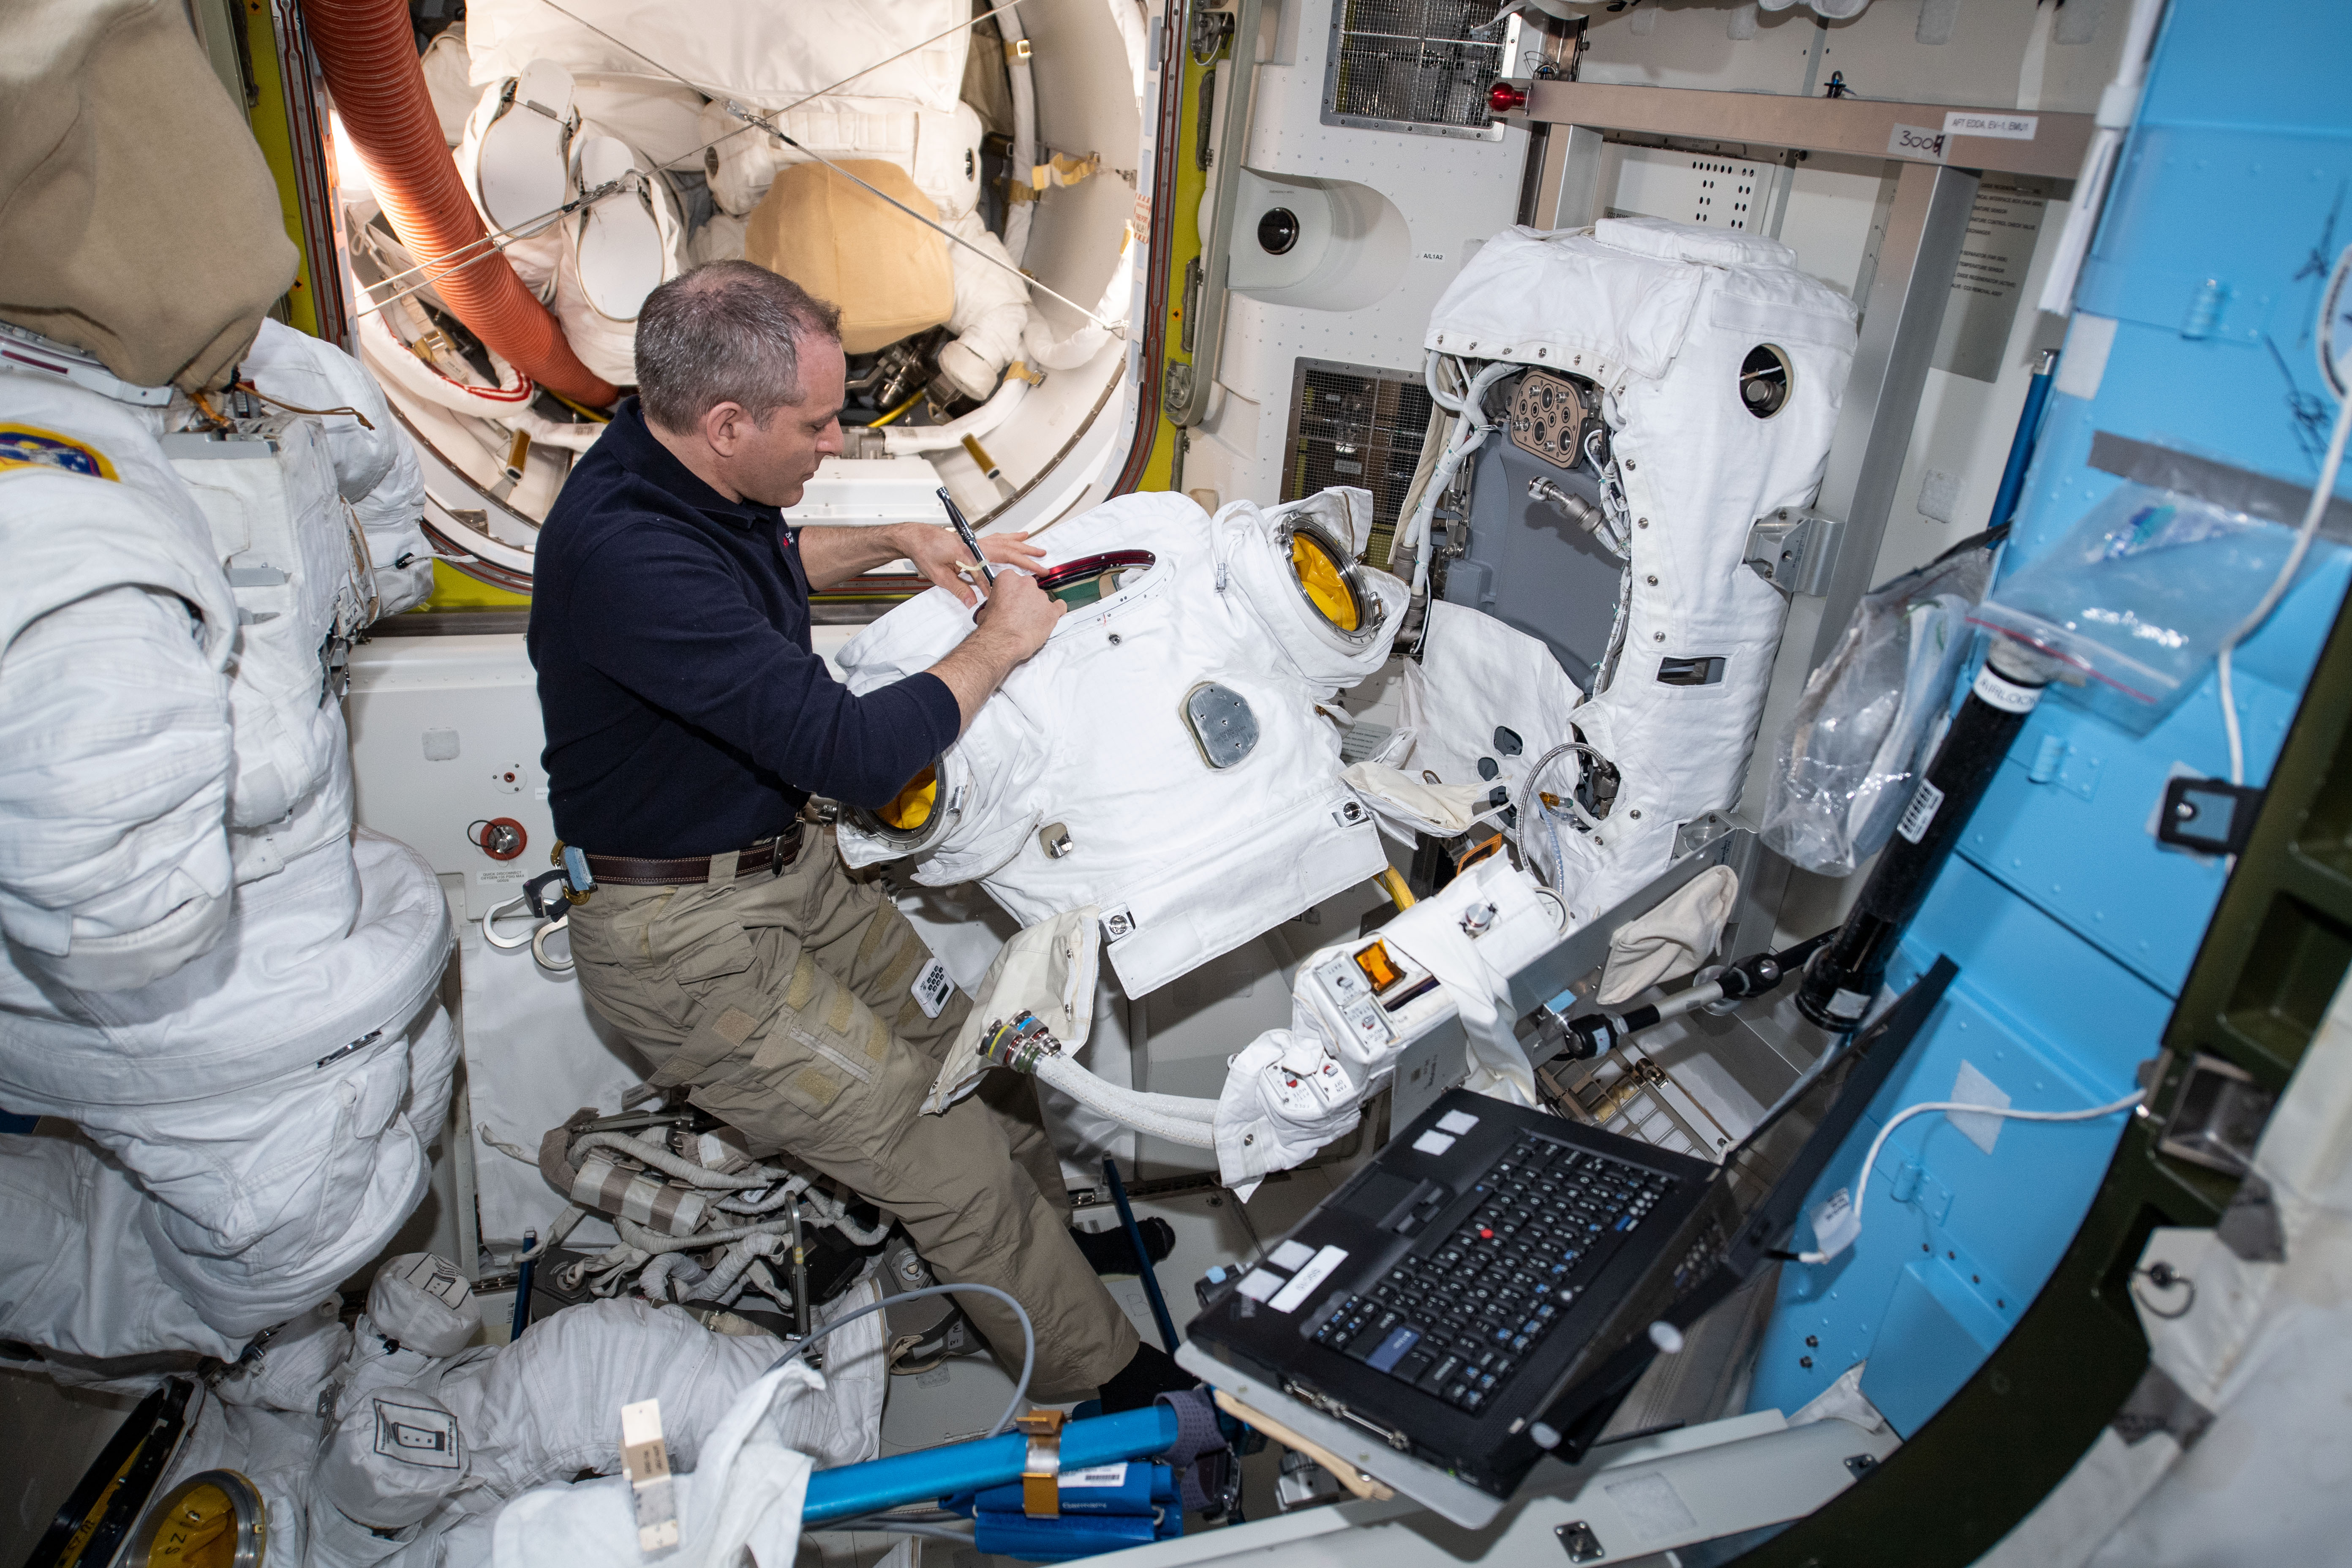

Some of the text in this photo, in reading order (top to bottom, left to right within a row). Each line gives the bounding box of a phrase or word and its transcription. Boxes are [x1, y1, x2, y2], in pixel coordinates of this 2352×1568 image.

[1328, 963, 1342, 975] BATT
[1348, 1006, 1370, 1021] STATUS
[1334, 1080, 1343, 1088] OFF
[1336, 1084, 1347, 1092] FAN
[1293, 1087, 1306, 1097] MUTE
[1062, 1500, 1107, 1511] Germany
